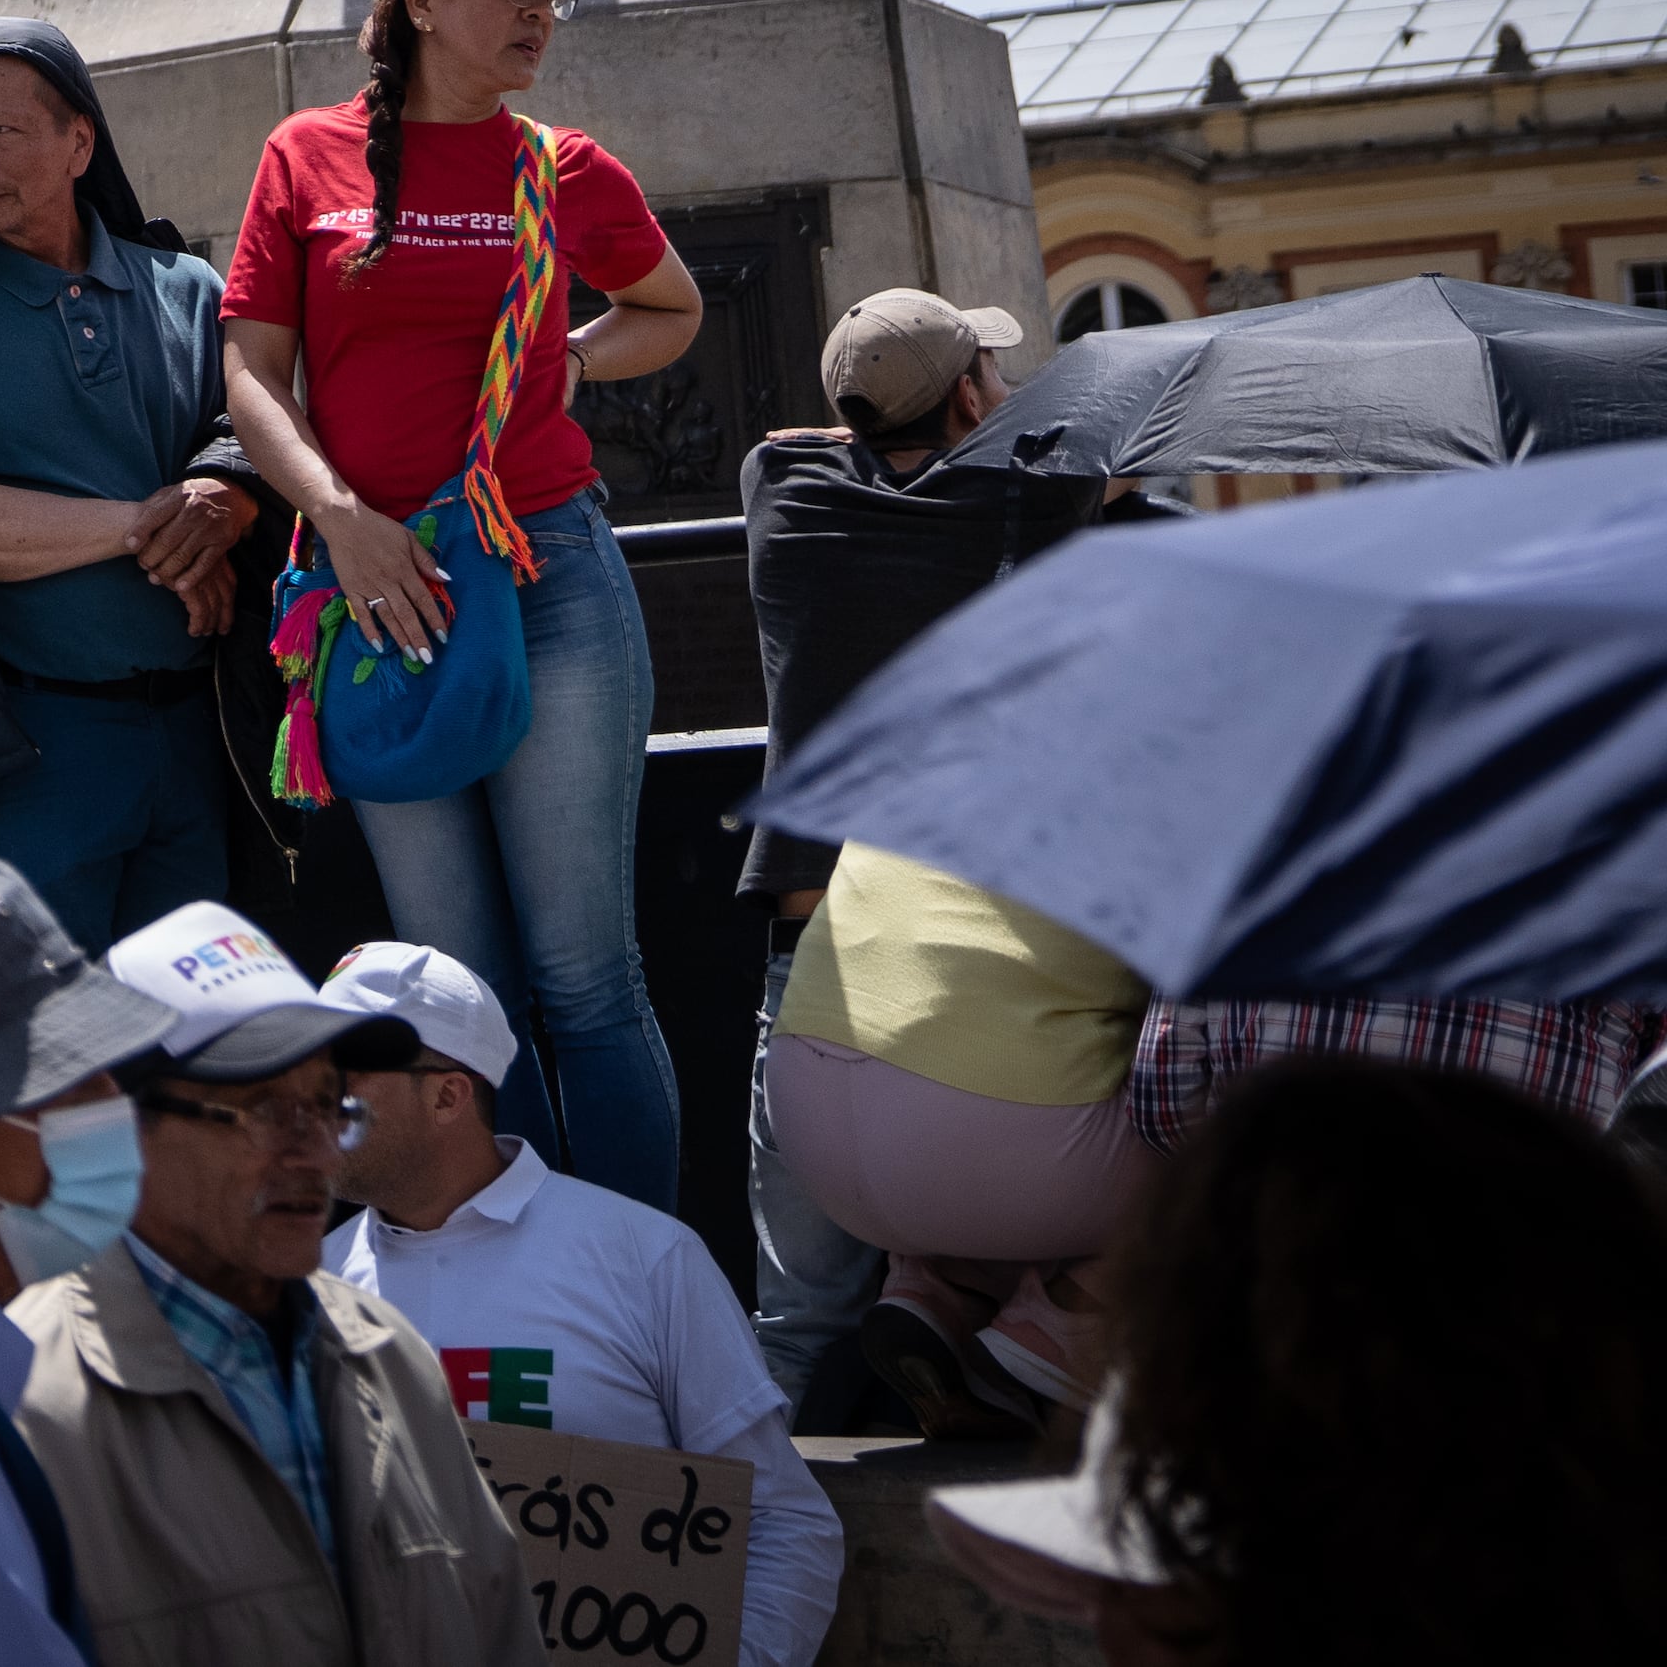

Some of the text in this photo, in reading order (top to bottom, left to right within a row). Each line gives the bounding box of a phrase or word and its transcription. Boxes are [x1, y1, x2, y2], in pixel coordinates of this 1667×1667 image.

[356, 230, 373, 239] FIN
[412, 236, 445, 247] PLACE
[461, 238, 481, 246] THE
[484, 238, 515, 247] WORL
[171, 932, 279, 982] PETRO
[440, 1347, 554, 1429] FE
[641, 1466, 732, 1567] de
